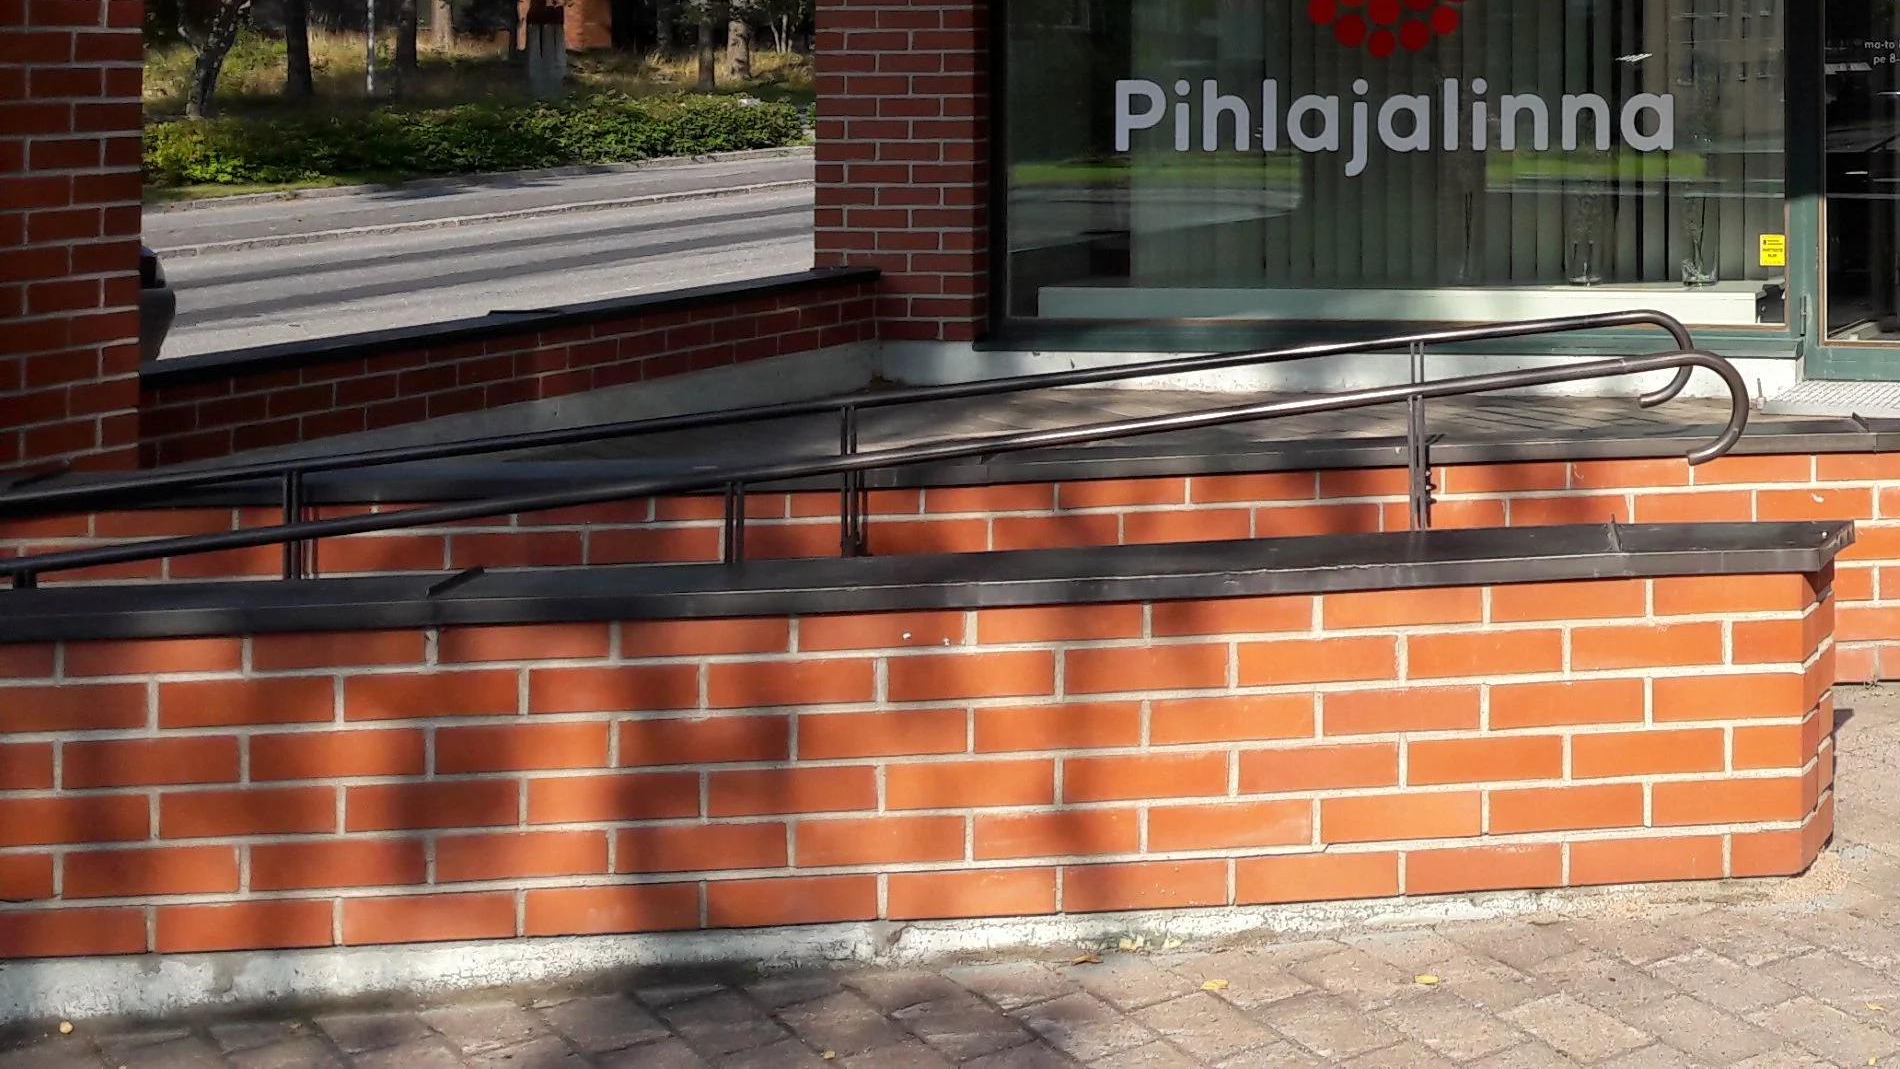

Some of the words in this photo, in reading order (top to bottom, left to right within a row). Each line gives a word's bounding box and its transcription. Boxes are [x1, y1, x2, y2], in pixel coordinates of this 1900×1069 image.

[1864, 40, 1895, 49] ma-to
[1873, 56, 1886, 65] pe
[1114, 78, 1674, 177] Pihlajalinna
